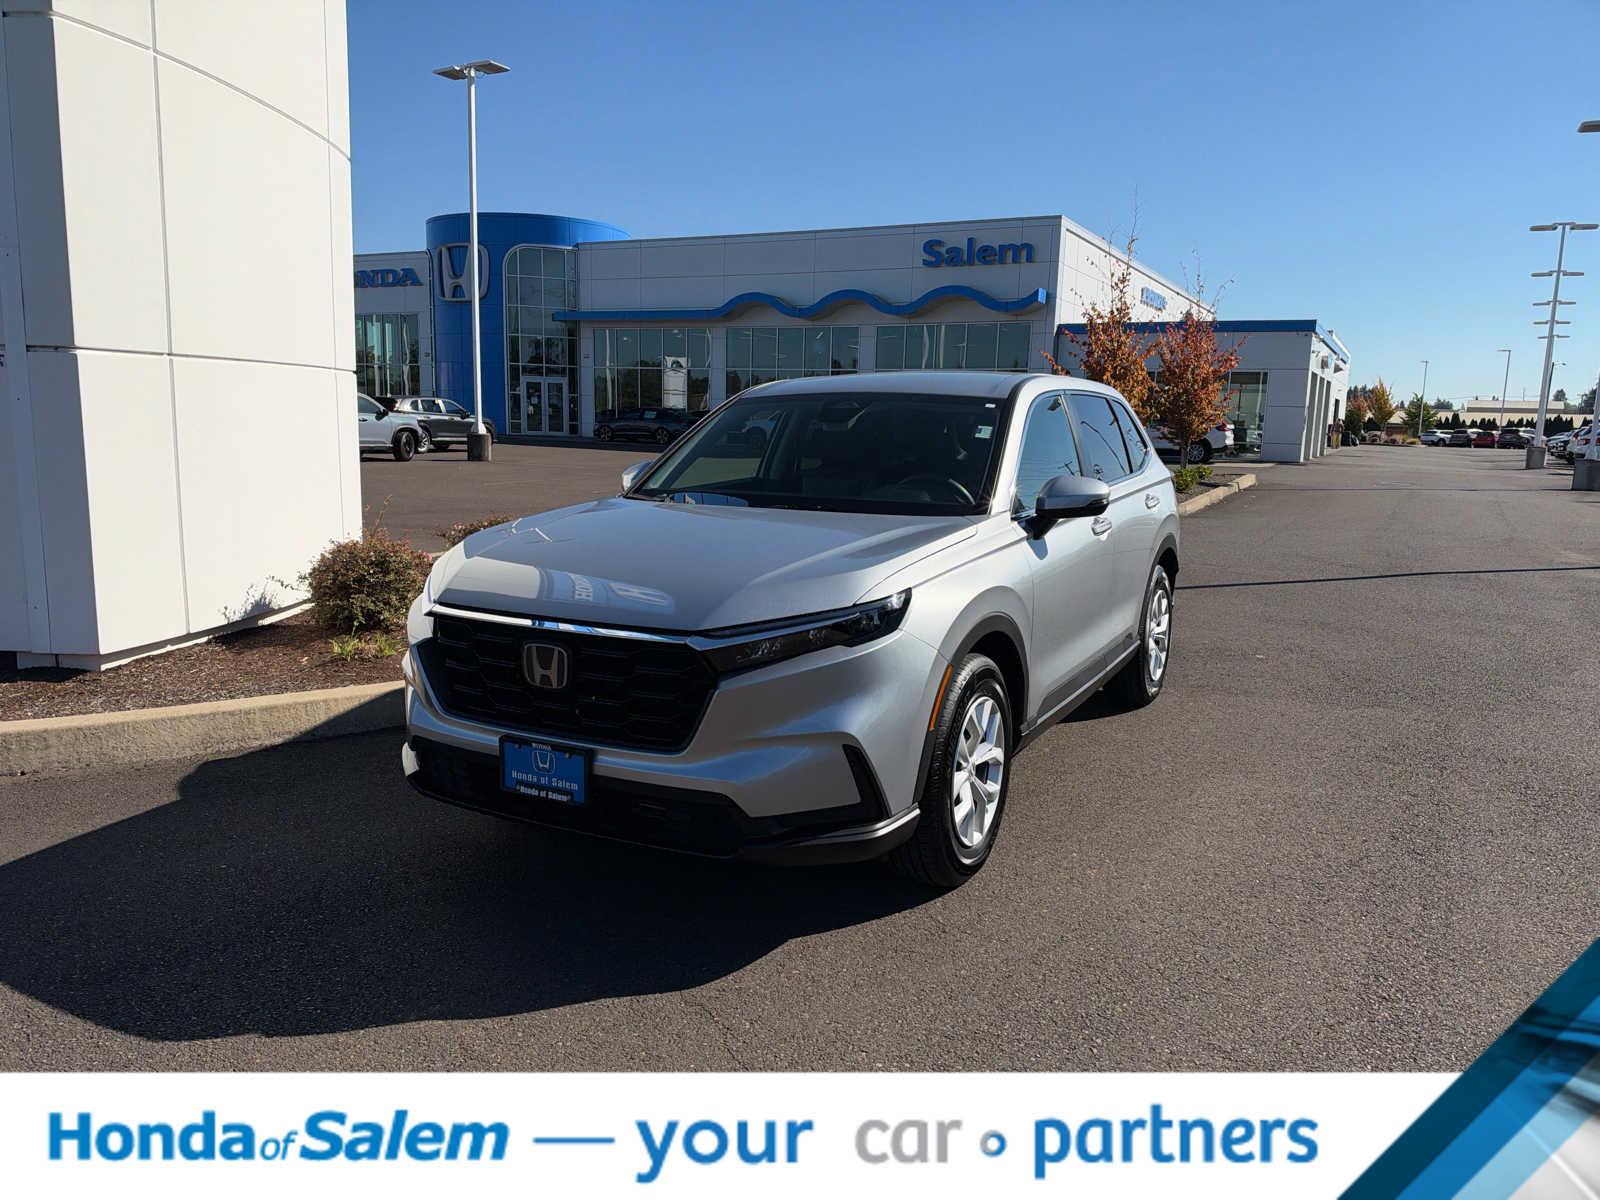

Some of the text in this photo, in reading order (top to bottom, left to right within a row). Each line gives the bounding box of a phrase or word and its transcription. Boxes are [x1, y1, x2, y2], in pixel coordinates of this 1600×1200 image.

[922, 237, 1033, 268] Salem
[354, 267, 424, 289] NDA
[512, 770, 537, 782] Honda
[551, 777, 578, 790] Salem
